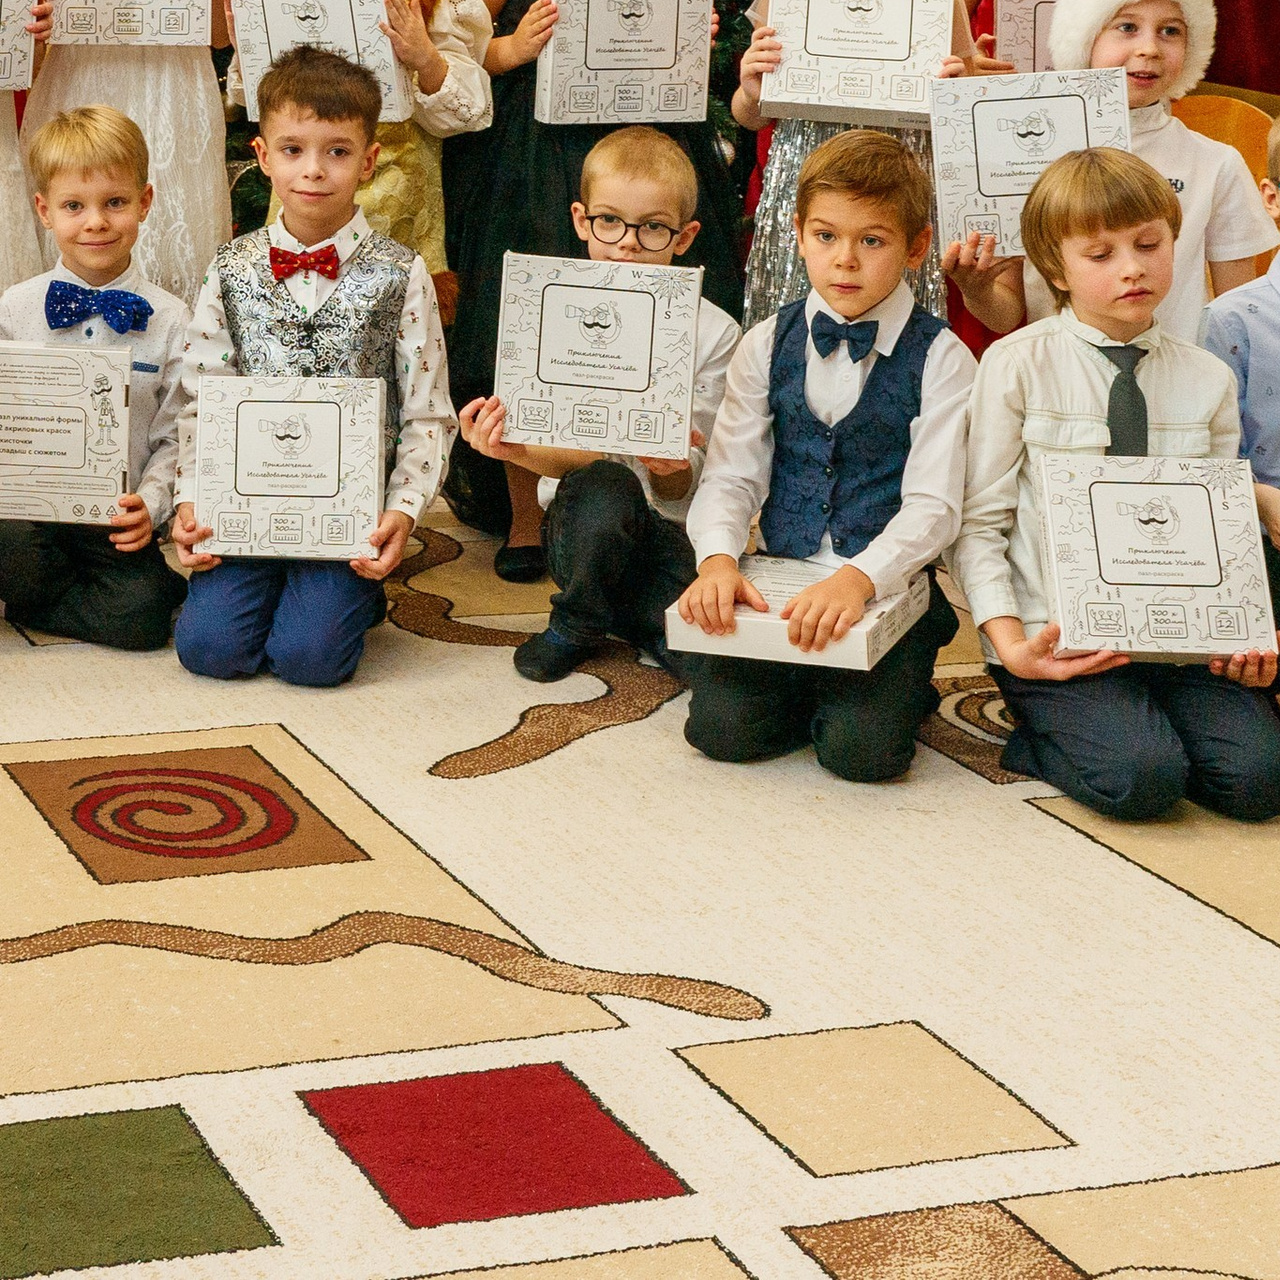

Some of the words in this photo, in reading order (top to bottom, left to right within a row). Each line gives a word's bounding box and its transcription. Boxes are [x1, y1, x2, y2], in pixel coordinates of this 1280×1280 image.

[166, 18, 179, 26] 12
[1057, 76, 1069, 84] W
[1096, 109, 1103, 118] S
[990, 170, 1041, 178] Исследовател
[632, 270, 643, 278] W
[665, 311, 671, 319] S
[568, 349, 622, 360] Приключения
[550, 358, 607, 369] Исследователя
[577, 409, 593, 417] 300
[56, 416, 83, 424] формы
[350, 418, 356, 426] S
[637, 423, 650, 432] 12
[262, 461, 312, 469] Приключения
[1179, 463, 1191, 471] W
[1222, 502, 1229, 510] S
[329, 526, 342, 535] 12
[1112, 558, 1172, 566] Исследователя
[1218, 620, 1233, 629] 12
